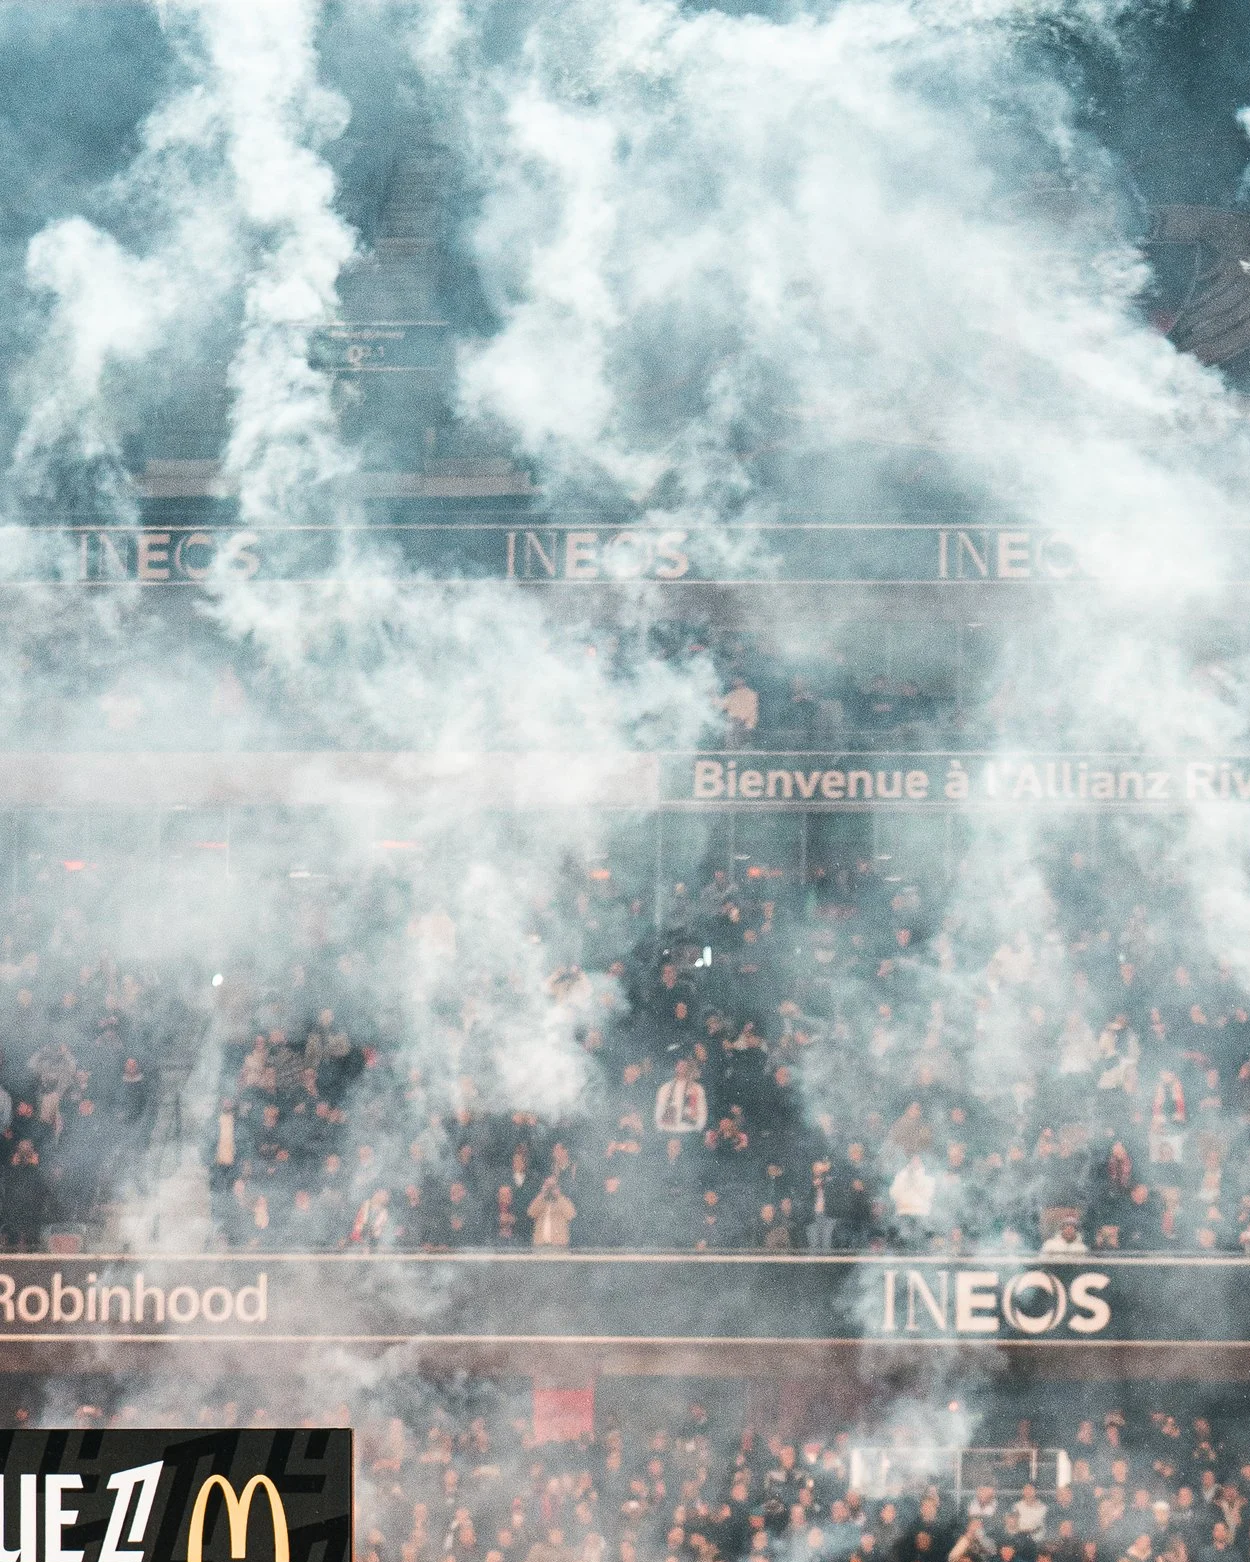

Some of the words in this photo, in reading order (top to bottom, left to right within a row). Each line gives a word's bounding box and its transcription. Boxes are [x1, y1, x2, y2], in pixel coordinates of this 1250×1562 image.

[79, 532, 260, 581] INEOS
[506, 531, 690, 580] INEOS
[694, 761, 927, 799] Bienvenue
[944, 760, 970, 799] à
[883, 1270, 1111, 1333] INEOS
